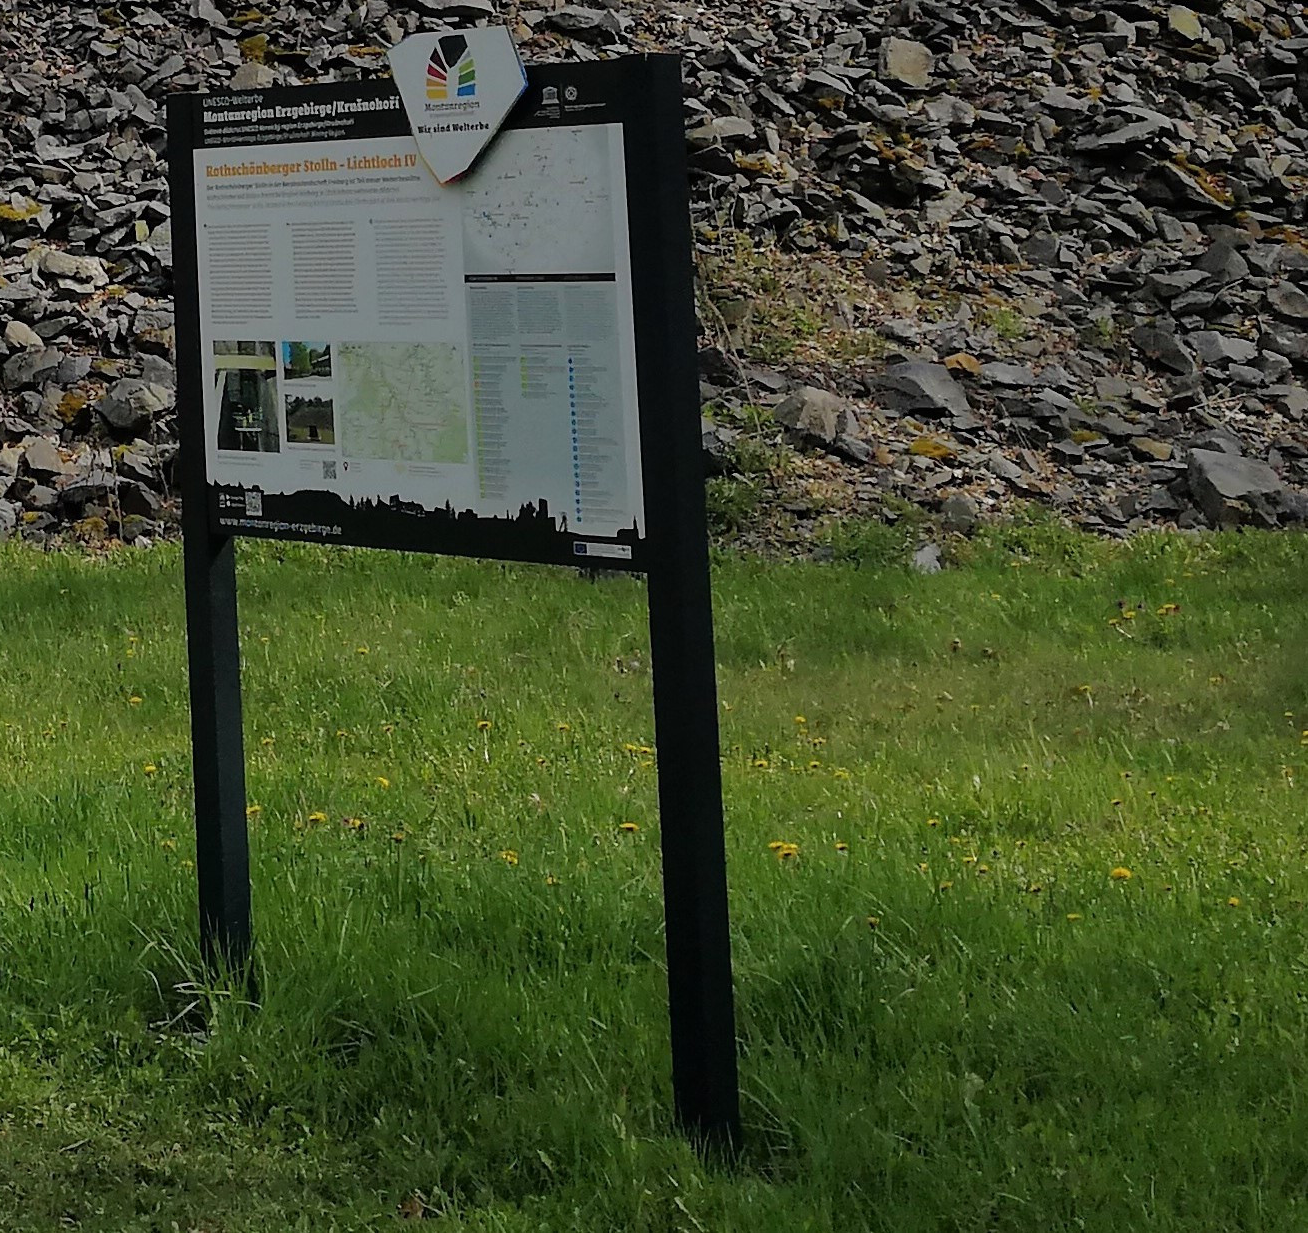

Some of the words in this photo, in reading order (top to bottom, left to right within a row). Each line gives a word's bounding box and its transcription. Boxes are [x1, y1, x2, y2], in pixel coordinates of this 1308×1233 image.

[203, 106, 274, 123] Montanregion
[275, 96, 400, 119] Erzgebirge/Krušnohoří
[418, 126, 431, 134] Wir
[433, 124, 450, 133] sind
[452, 122, 490, 132] Welterbe
[206, 161, 301, 178] Rothschönberger
[304, 156, 337, 173] Stolln
[347, 153, 402, 170] Lichtloch
[404, 154, 417, 168] IV
